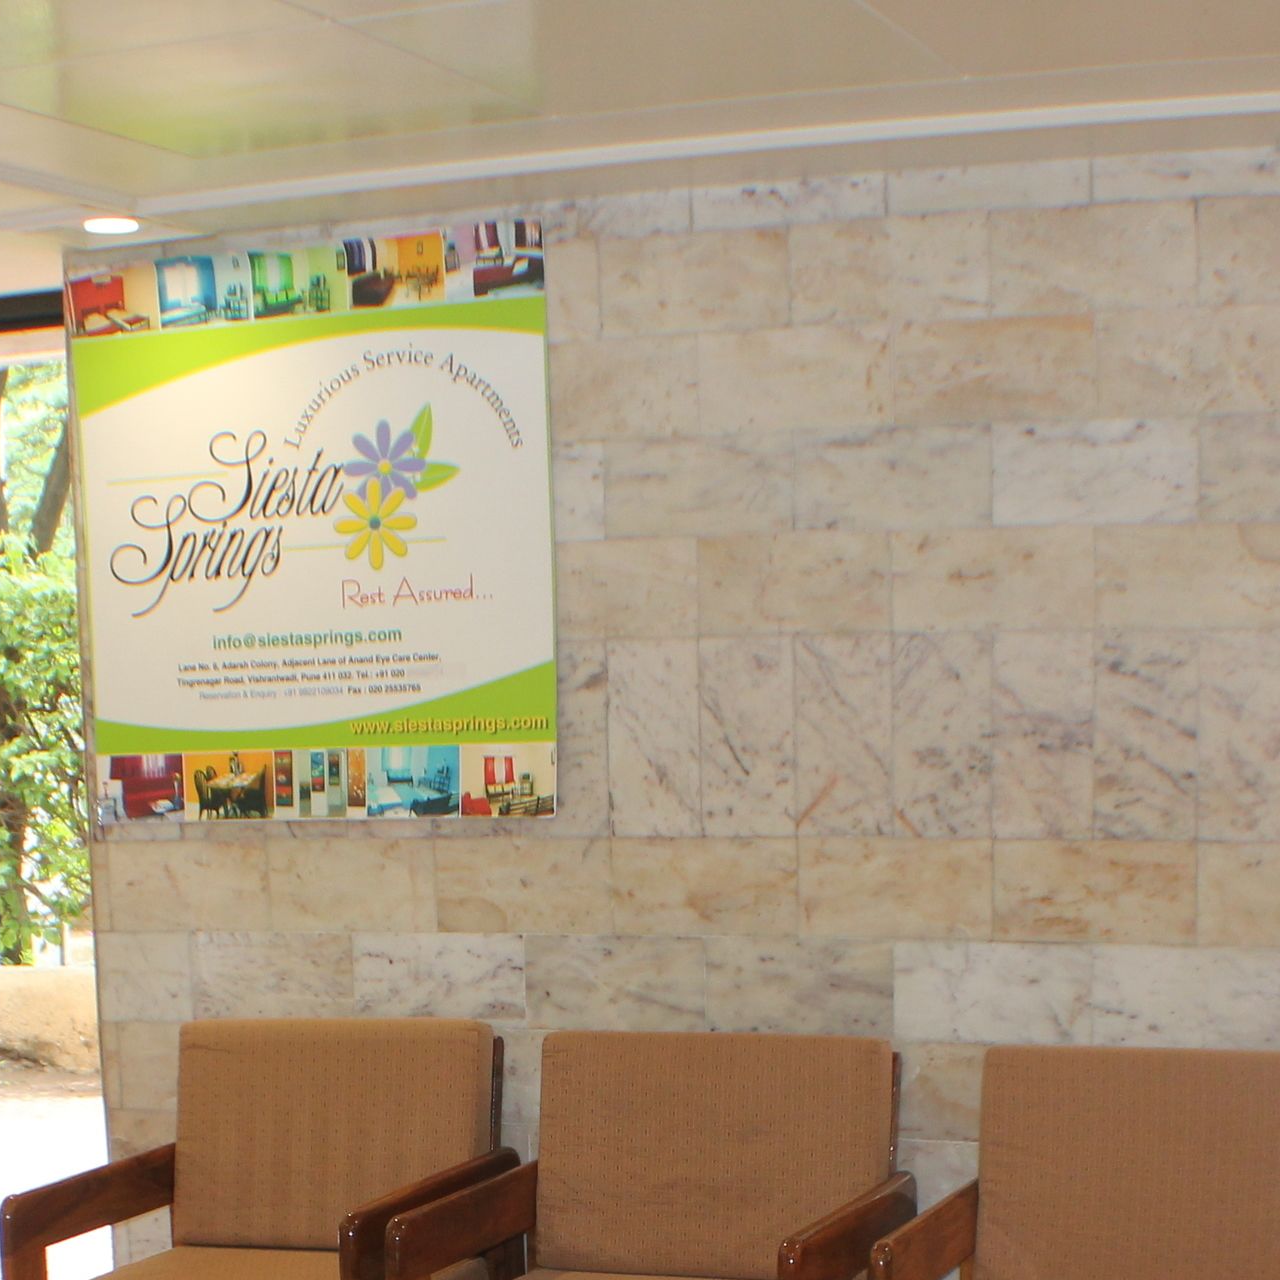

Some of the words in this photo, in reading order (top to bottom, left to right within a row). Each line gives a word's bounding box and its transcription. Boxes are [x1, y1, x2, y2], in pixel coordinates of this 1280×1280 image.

[283, 363, 360, 450] Luxurious
[363, 343, 434, 371] Service
[439, 352, 523, 449] Apartments
[187, 429, 344, 522] Siesta
[109, 493, 283, 618] Springs
[341, 579, 385, 609] Rest
[213, 628, 403, 650] info@siestasprings.com
[178, 663, 197, 673] Lane
[222, 661, 249, 671] Adarsh
[282, 657, 316, 670] Adjacent
[318, 656, 336, 666] Lane
[338, 656, 347, 665] of
[348, 655, 375, 665] Anand
[376, 655, 391, 665] Eye
[392, 653, 412, 663] Care
[300, 671, 321, 681] Pune
[322, 671, 336, 681] 411
[375, 669, 389, 679] +91
[391, 668, 405, 678] 020
[347, 684, 362, 695] Fax
[368, 683, 383, 694] 020
[349, 714, 549, 737] www.siestasprings.com
